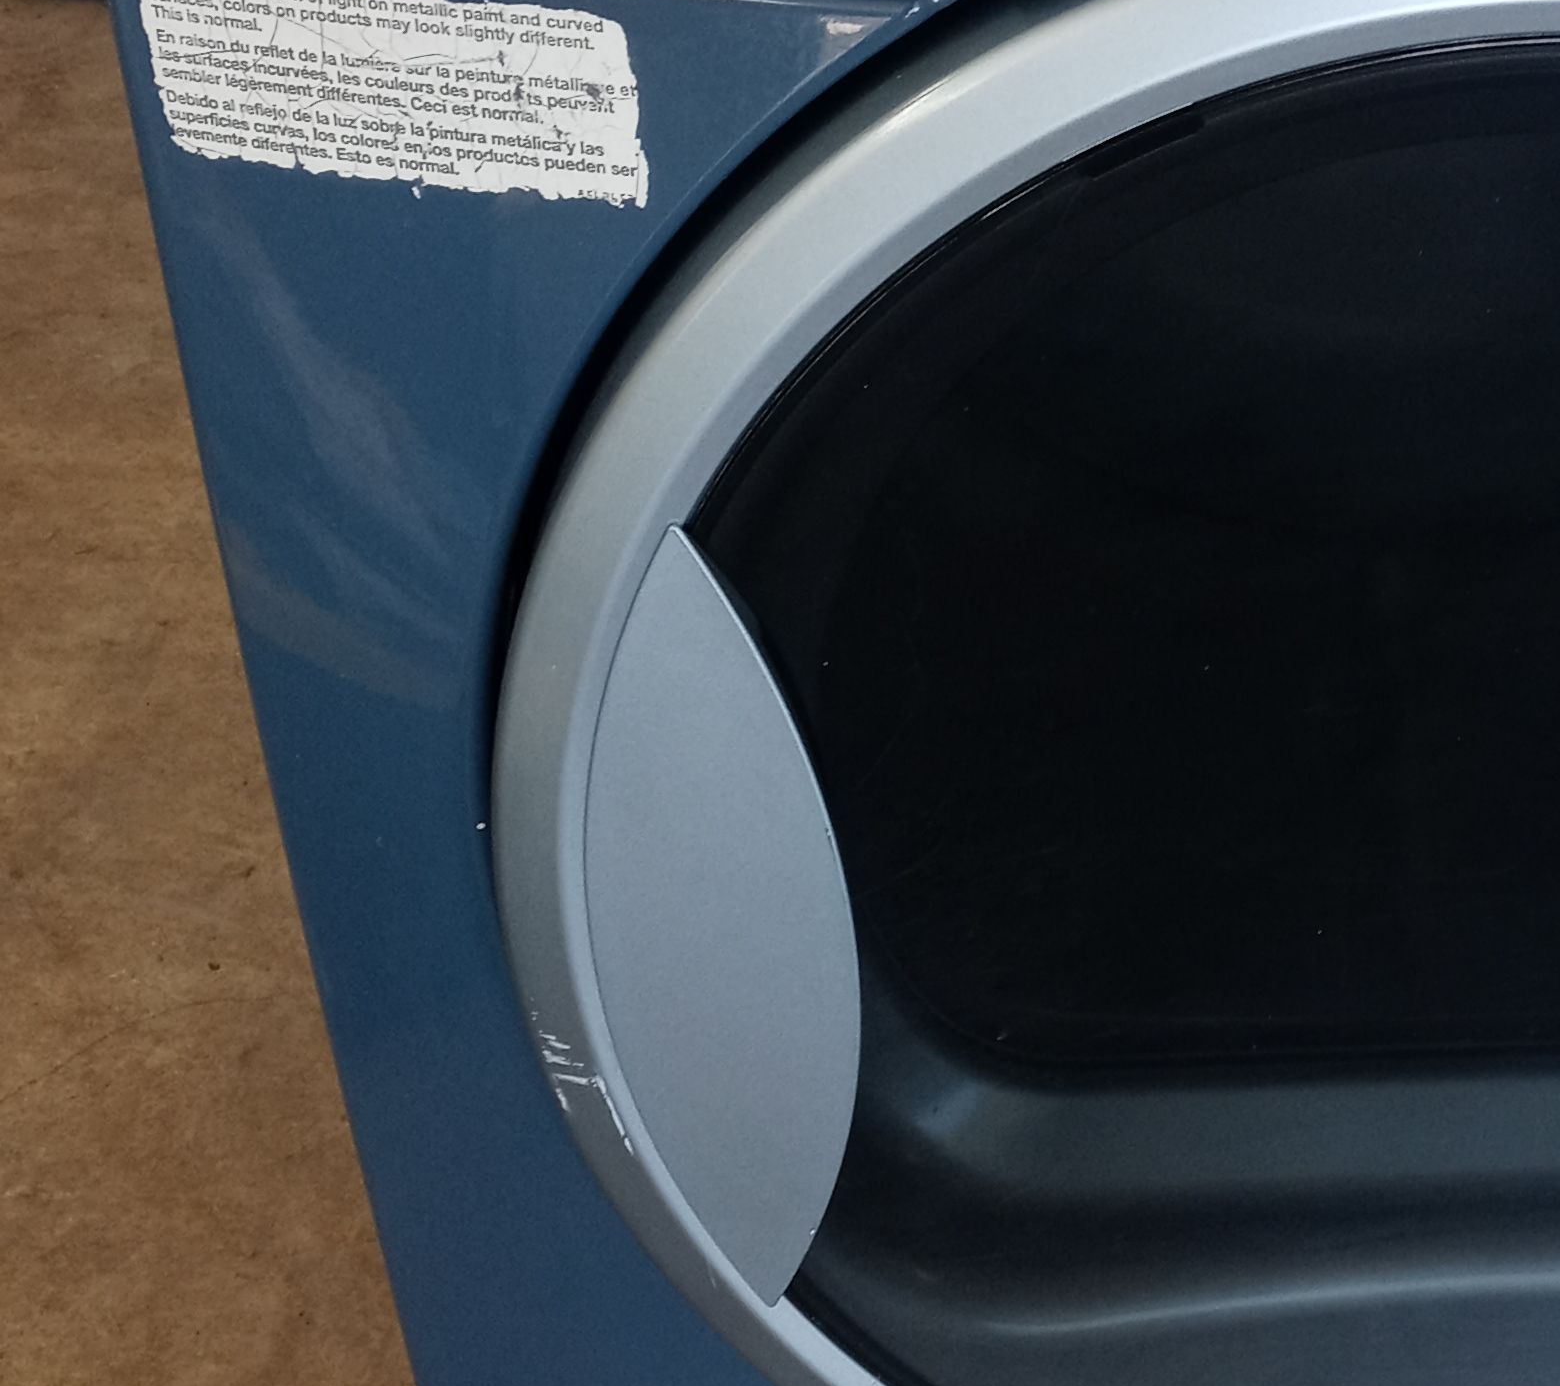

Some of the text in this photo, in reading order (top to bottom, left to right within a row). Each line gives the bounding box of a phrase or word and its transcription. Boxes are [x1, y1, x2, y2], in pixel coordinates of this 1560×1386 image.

[151, 5, 262, 32] This is normal.
[223, 0, 595, 50] colors on products may look slightly different.
[368, 0, 388, 11] on
[393, 1, 458, 18] metallic
[510, 12, 540, 27] and
[547, 17, 603, 33] curved
[156, 29, 449, 78] En raison du reflet de la la
[162, 67, 544, 124] sembler légèrement Ceci est normal.
[253, 59, 469, 98] incurvées, les couleurs des
[166, 89, 218, 109] Debido
[222, 99, 235, 111] al
[240, 102, 287, 120] reflejo
[292, 108, 312, 122] de
[316, 111, 330, 126] la
[333, 114, 357, 128] luz
[411, 123, 424, 137] la
[429, 126, 486, 144] pintura
[491, 133, 561, 152] metálica
[580, 142, 604, 157] las
[169, 108, 638, 177] superficies curvas, los en productos pueden ser
[252, 137, 460, 175] diferentes. Esto es normal.
